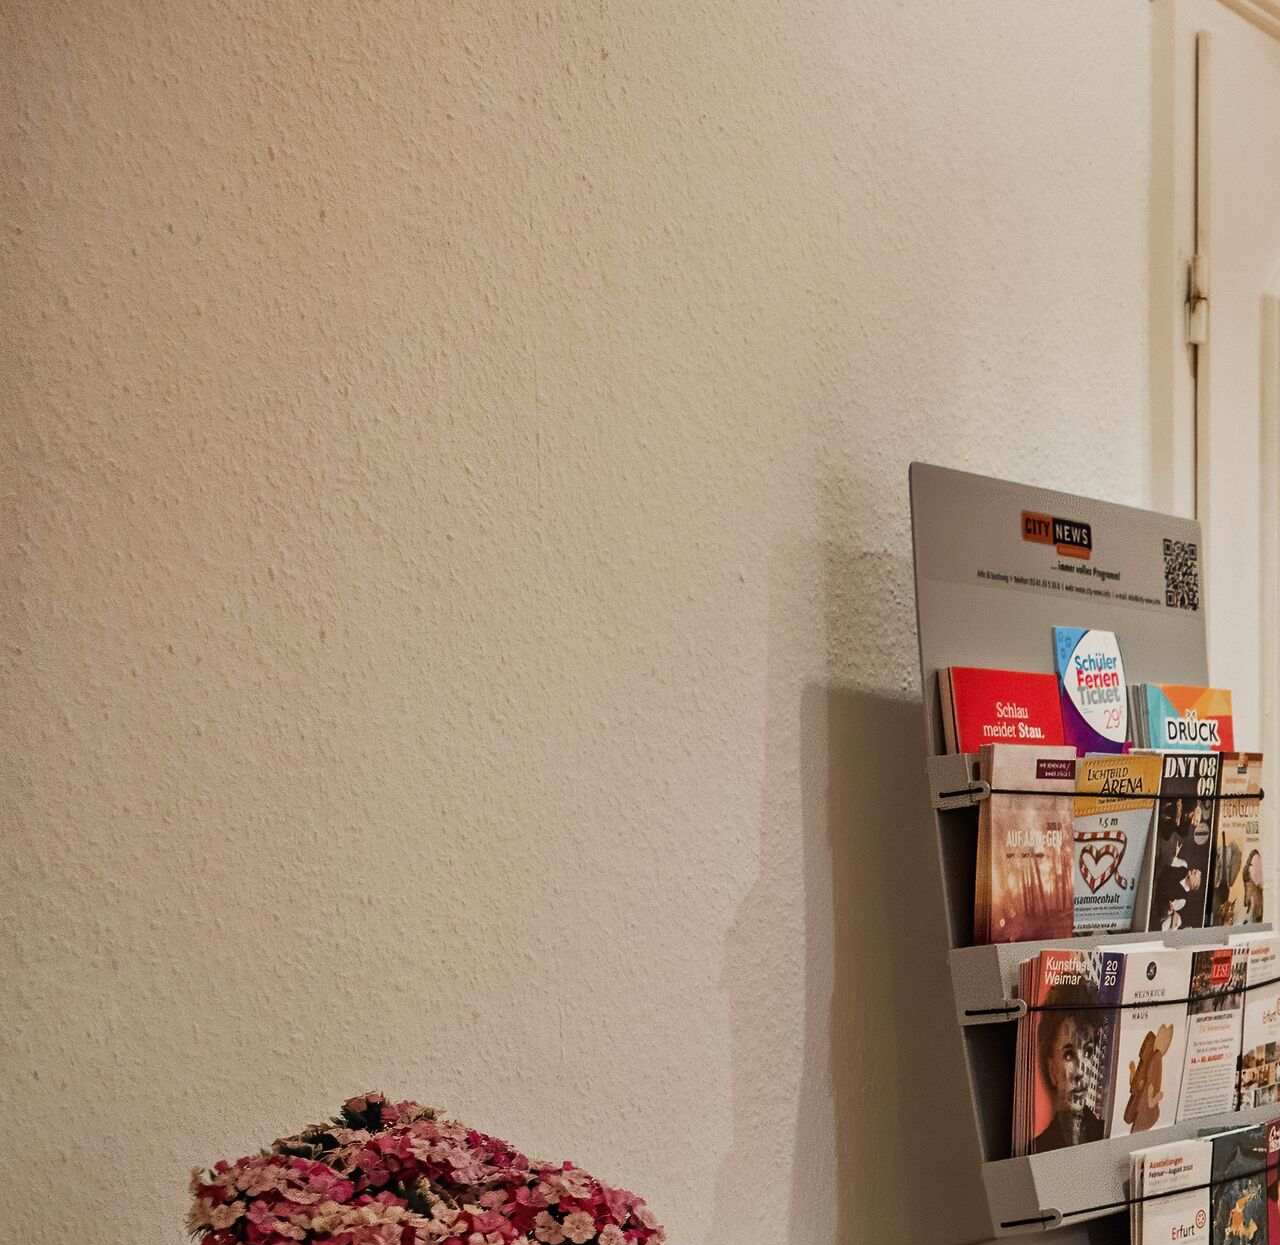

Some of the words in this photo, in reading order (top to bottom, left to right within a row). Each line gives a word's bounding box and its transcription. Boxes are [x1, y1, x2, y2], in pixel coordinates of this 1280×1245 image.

[1024, 516, 1050, 538] CITY
[1055, 525, 1089, 545] NEWS
[1075, 655, 1118, 671] Schüler
[1076, 670, 1119, 689] Ferien
[1078, 686, 1121, 706] Ticket
[996, 702, 1028, 718] Schlau
[983, 723, 1017, 738] meidet
[1018, 722, 1045, 739] Stau.
[1164, 757, 1198, 778] DNT
[1199, 758, 1217, 777] 08
[1100, 777, 1143, 794] ARENA
[1197, 777, 1215, 796] 09
[1045, 956, 1091, 971] Kunstfest
[1106, 960, 1118, 972] 20
[1044, 971, 1082, 986] Weimar
[1104, 975, 1117, 987] 20
[1171, 1224, 1195, 1241] Erfurt
